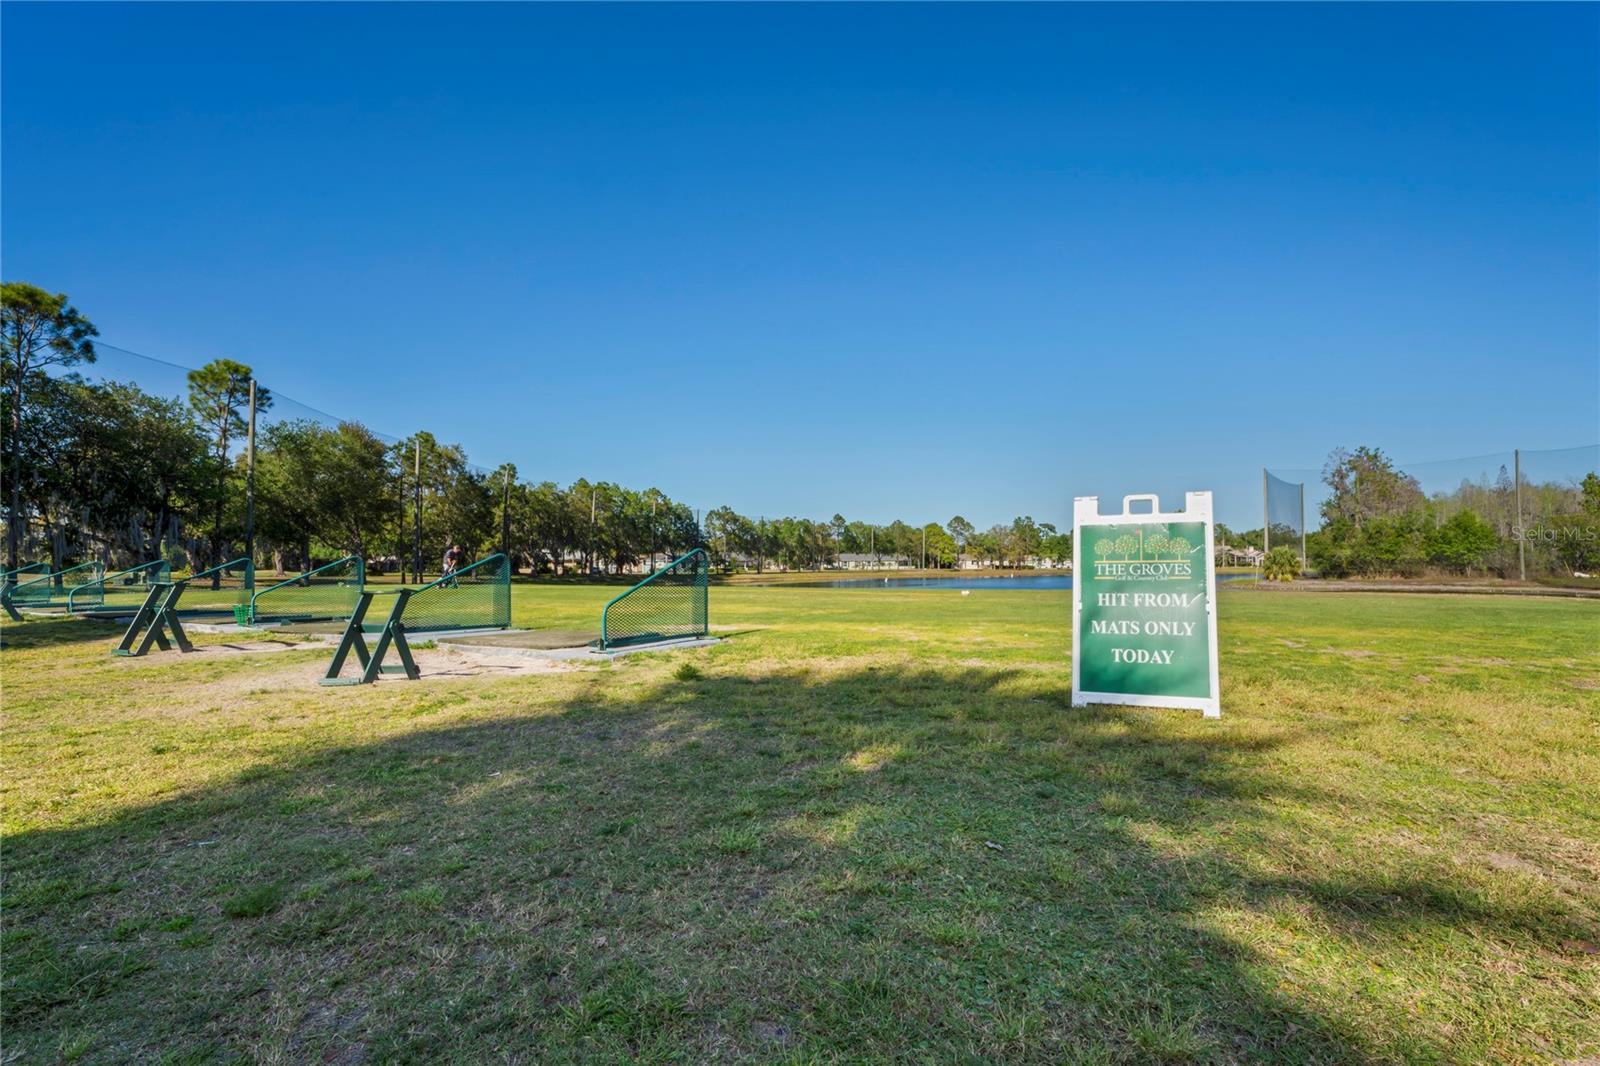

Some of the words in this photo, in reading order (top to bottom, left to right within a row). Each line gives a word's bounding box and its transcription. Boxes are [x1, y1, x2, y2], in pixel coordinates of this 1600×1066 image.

[1094, 563, 1126, 576] THE
[1129, 563, 1192, 576] GROVES
[1097, 592, 1129, 607] HIT
[1133, 592, 1187, 608] FROM
[1091, 620, 1140, 635] MATS
[1144, 621, 1196, 636] ONLY
[1111, 648, 1175, 665] TODAY
